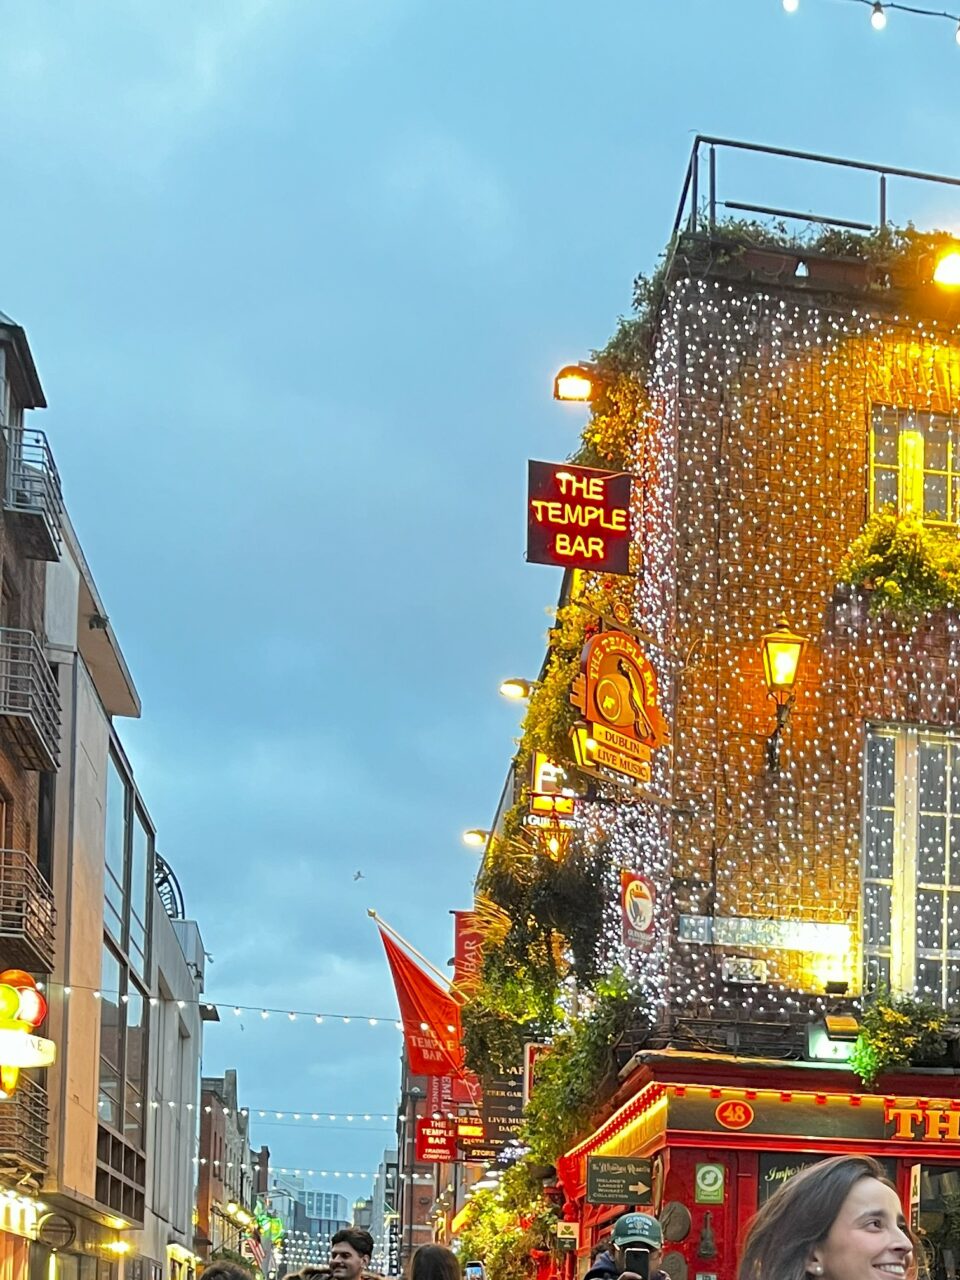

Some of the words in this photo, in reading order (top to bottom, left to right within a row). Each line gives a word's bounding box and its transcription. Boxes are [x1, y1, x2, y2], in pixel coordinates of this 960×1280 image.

[556, 472, 604, 500] THE
[531, 501, 627, 531] TEMPLE
[556, 534, 604, 559] BAR
[590, 647, 604, 680] THE
[601, 636, 645, 669] TEMPLE
[643, 671, 655, 707] BAR
[605, 731, 640, 754] DUBLIN
[598, 749, 617, 766] LIVE
[619, 757, 648, 778] MUSIC
[463, 940, 477, 972] BAR
[409, 1035, 456, 1052] TEMPE
[422, 1049, 444, 1062] BAR
[722, 1103, 746, 1122] 48
[421, 1128, 455, 1138] TEMPLE
[430, 1121, 447, 1129] THE
[428, 1137, 447, 1145] BAR
